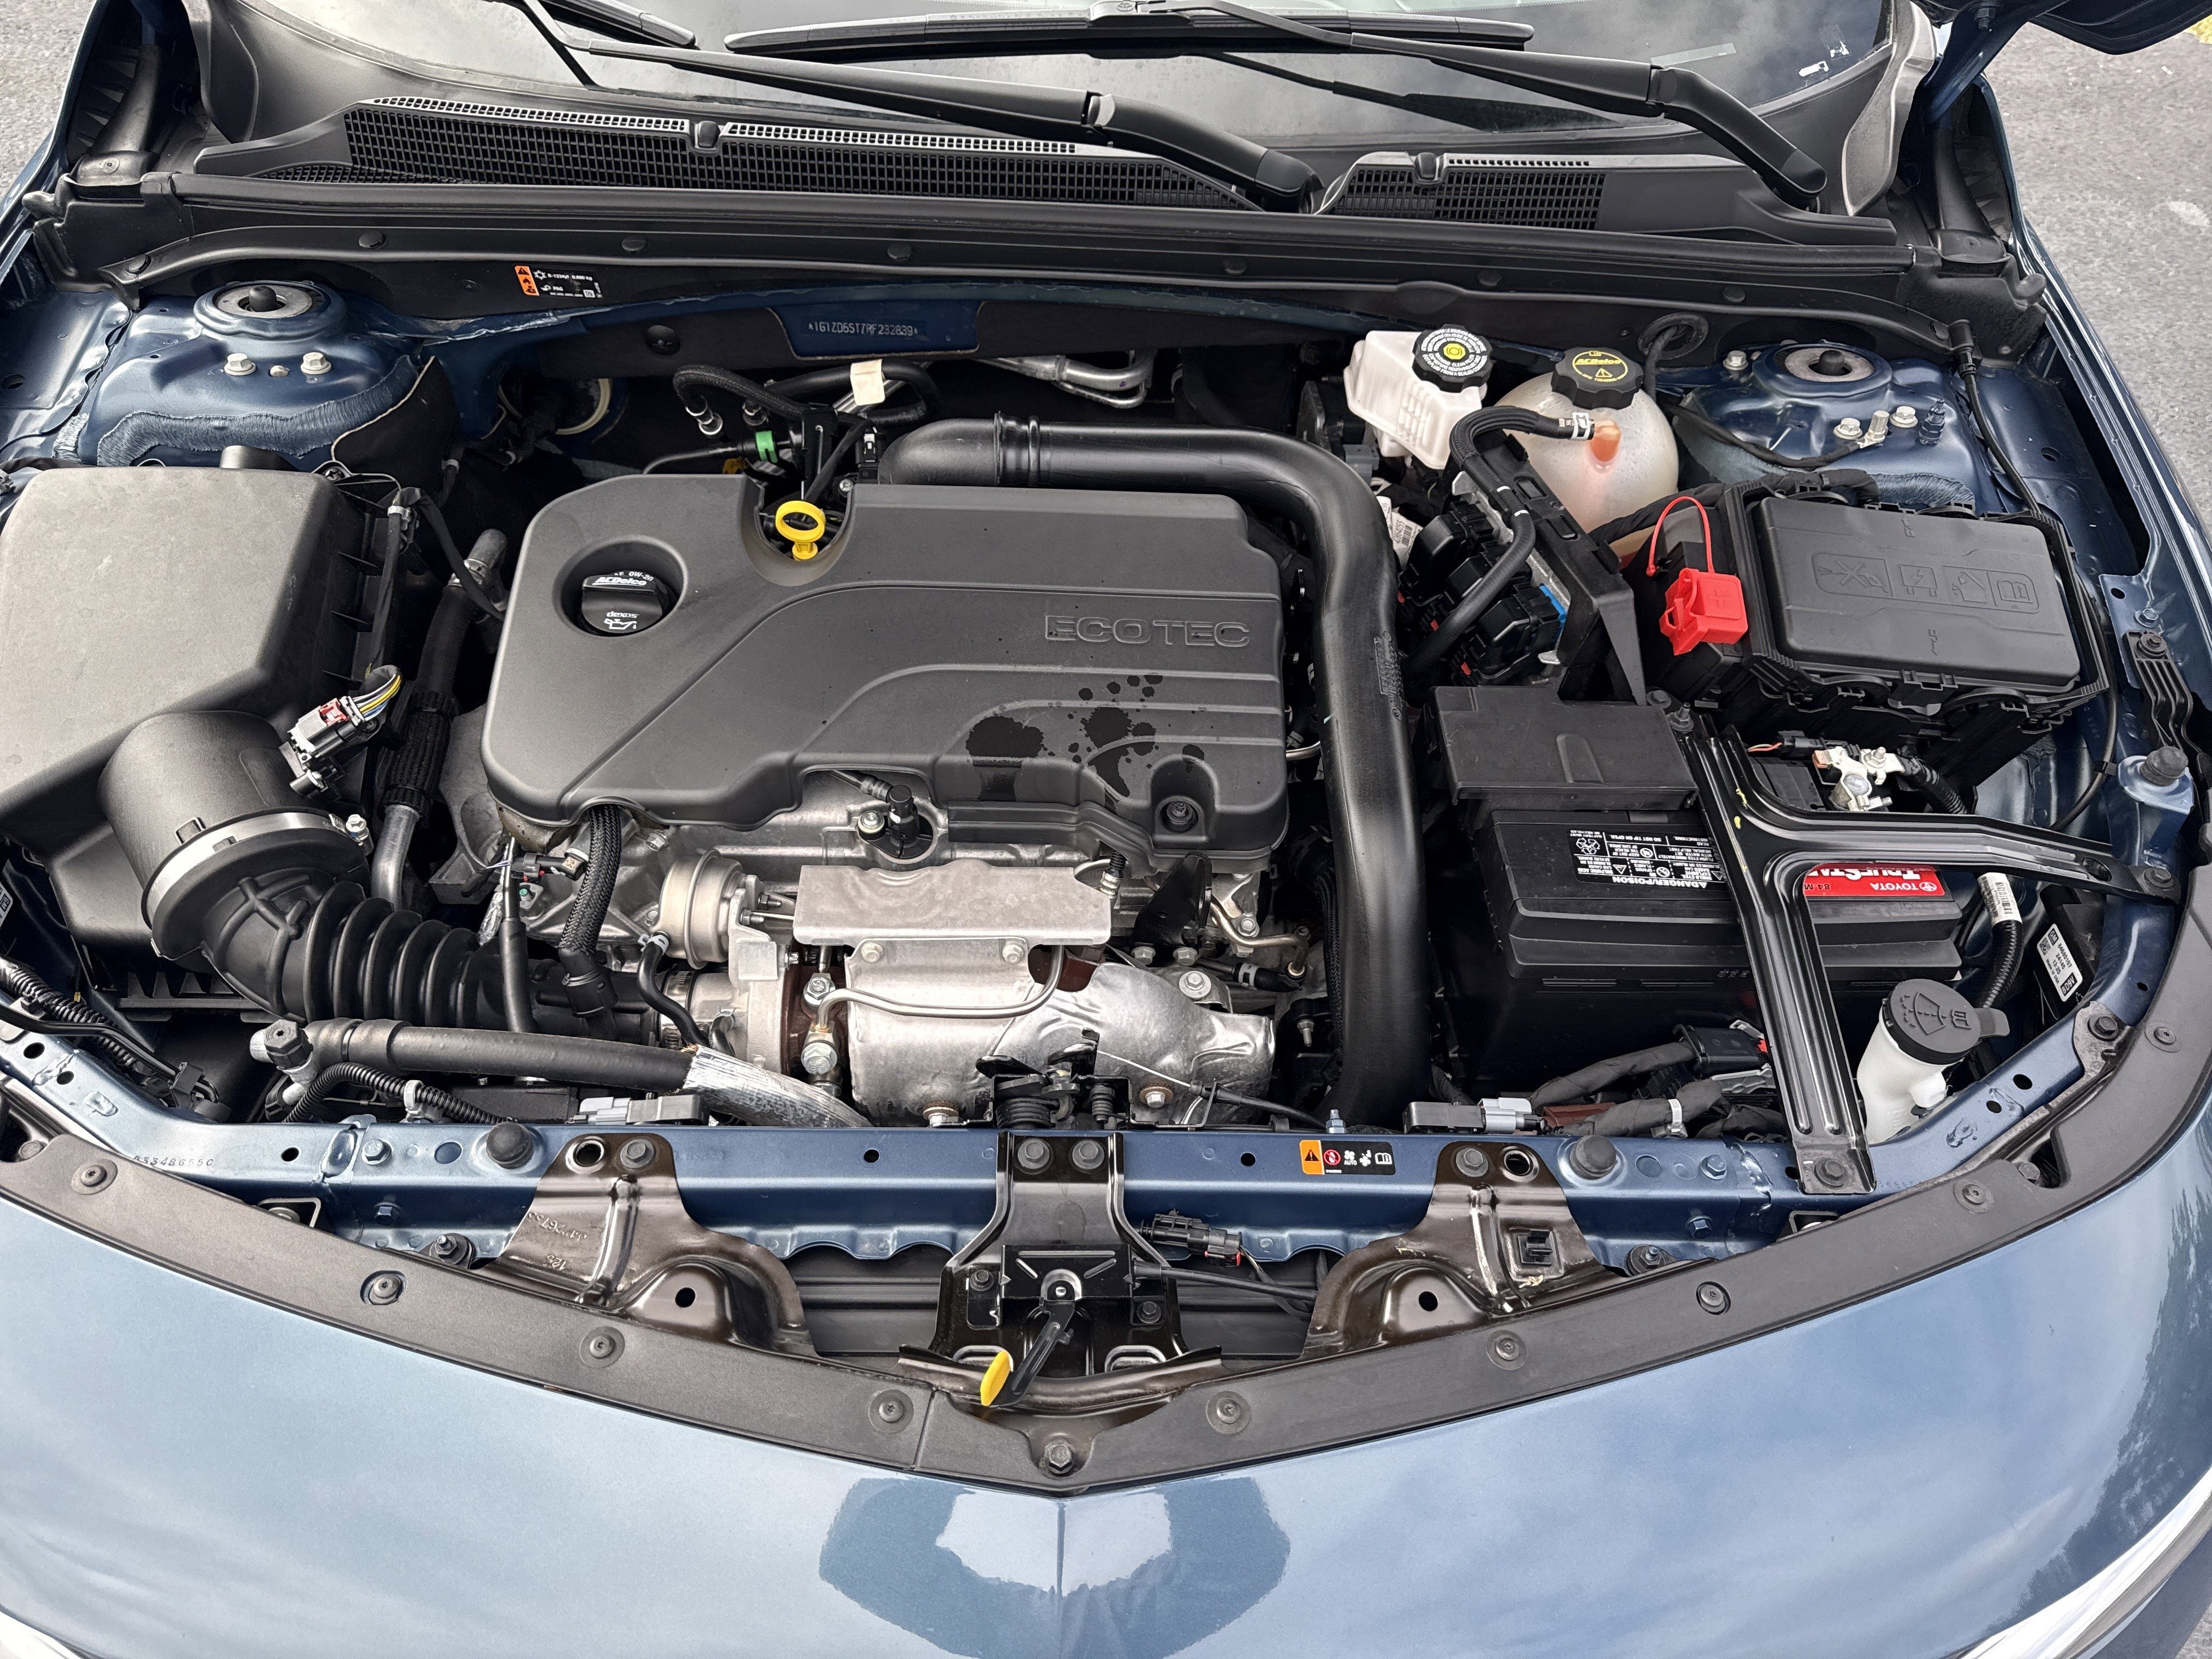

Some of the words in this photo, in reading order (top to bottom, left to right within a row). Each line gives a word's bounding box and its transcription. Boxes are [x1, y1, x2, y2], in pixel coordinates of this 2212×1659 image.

[595, 577, 647, 585] ACDelco
[1045, 615, 1250, 647] ECOTEC
[1612, 876, 1699, 888] DANGER/POISON
[1870, 882, 1919, 891] TOYOTA
